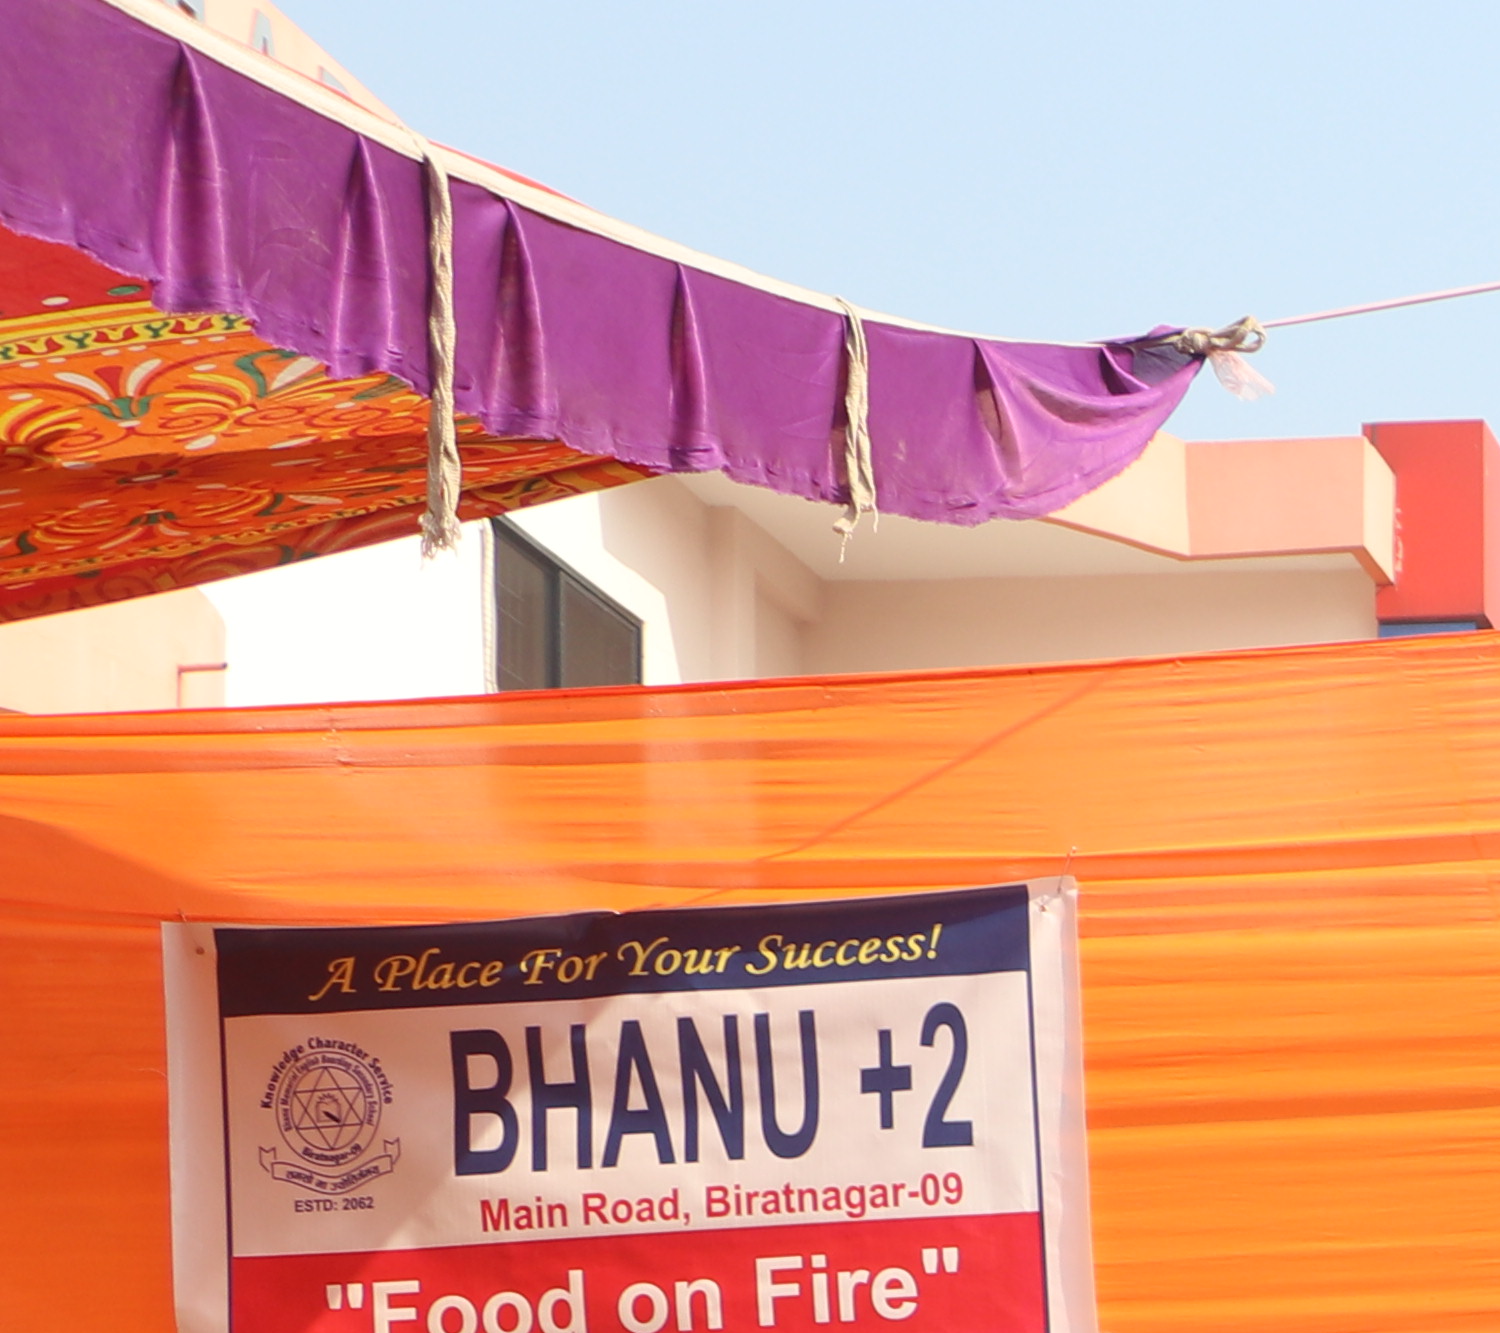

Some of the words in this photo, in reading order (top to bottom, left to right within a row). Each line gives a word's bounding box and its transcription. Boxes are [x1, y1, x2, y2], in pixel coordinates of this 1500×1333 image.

[309, 957, 356, 1000] A
[374, 948, 503, 991] Place
[520, 949, 607, 984] For
[618, 937, 740, 975] Your
[746, 924, 941, 974] Success!
[261, 1044, 304, 1109] Knowledge
[307, 1037, 369, 1060] Character
[368, 1057, 393, 1104] Service
[449, 1010, 819, 1176] BHANU
[861, 1002, 973, 1148] +2
[294, 1199, 337, 1213] ESTD:
[343, 1197, 374, 1210] 2062
[480, 1197, 567, 1232] Main
[583, 1189, 689, 1225] Road,
[706, 1173, 962, 1218] Biratnagar-09
[619, 1279, 722, 1333] on
[756, 1247, 958, 1326] Fire"
